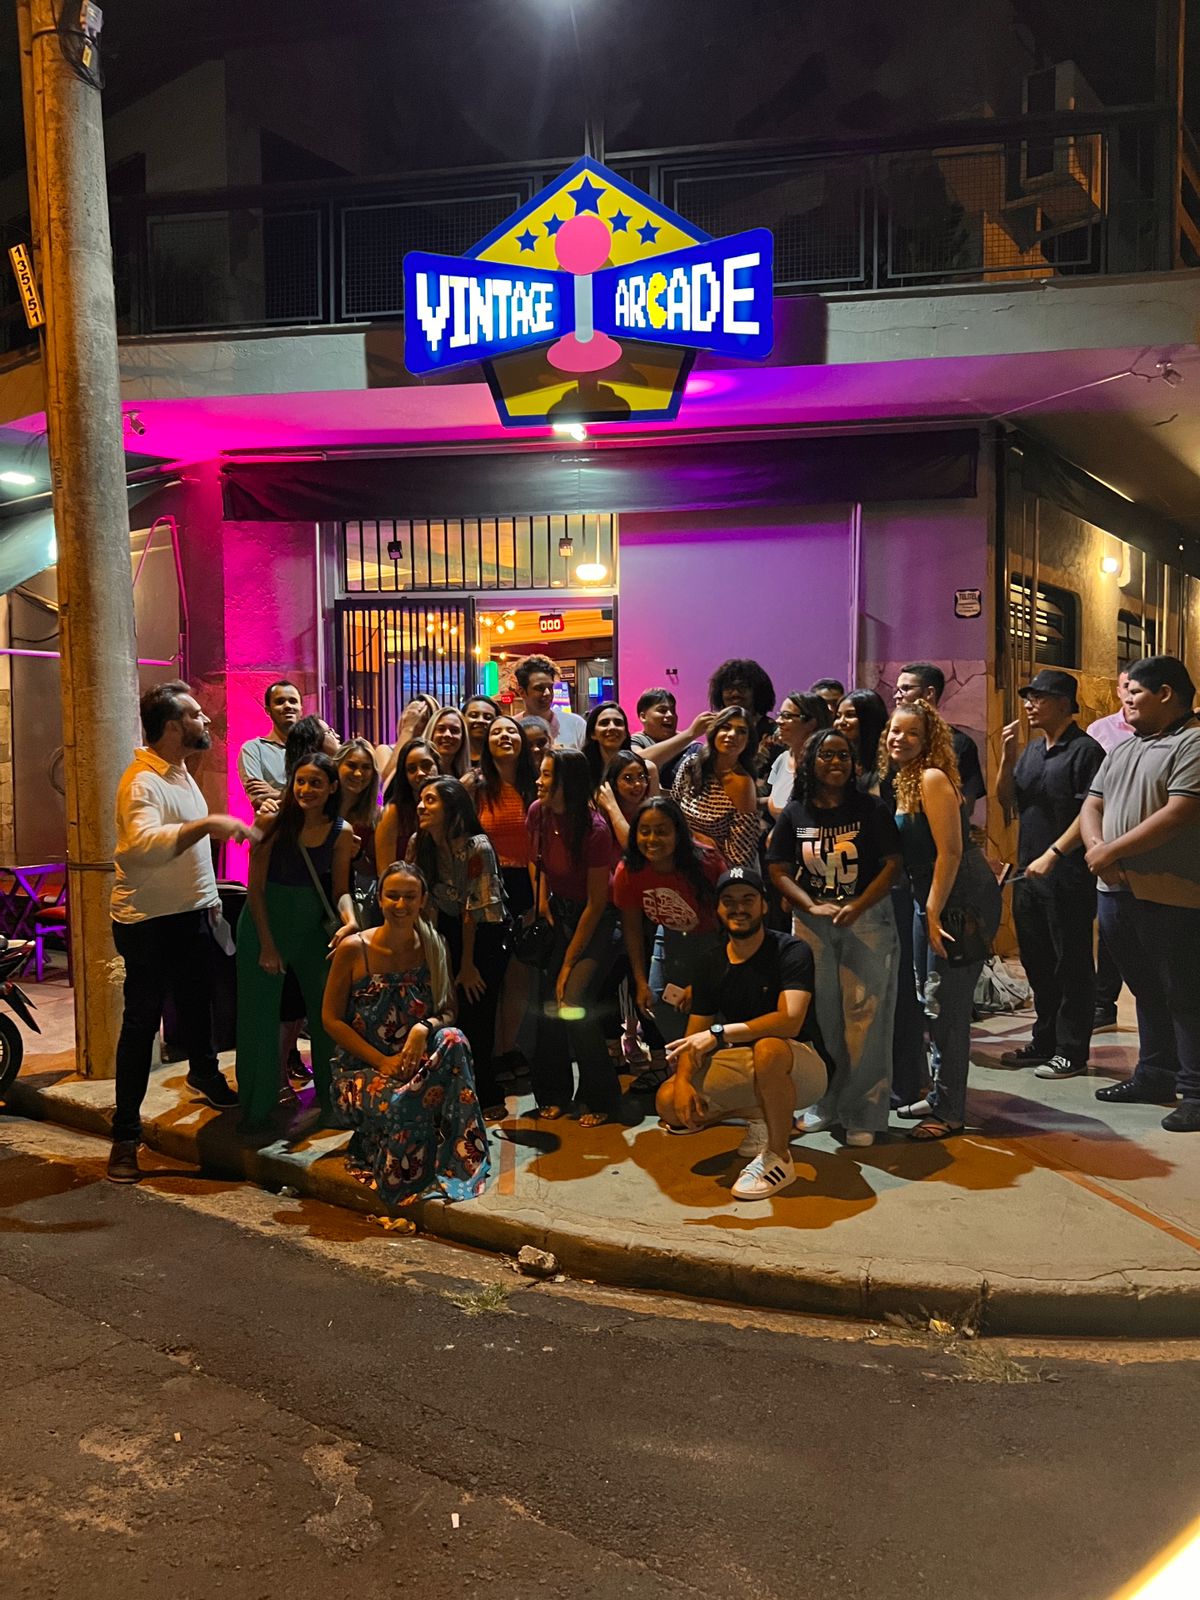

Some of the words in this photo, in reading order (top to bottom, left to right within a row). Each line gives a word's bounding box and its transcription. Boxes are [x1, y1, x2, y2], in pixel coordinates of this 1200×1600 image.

[14, 246, 40, 322] 135151
[416, 273, 554, 351] VINTAGE
[615, 252, 760, 334] ARCADE
